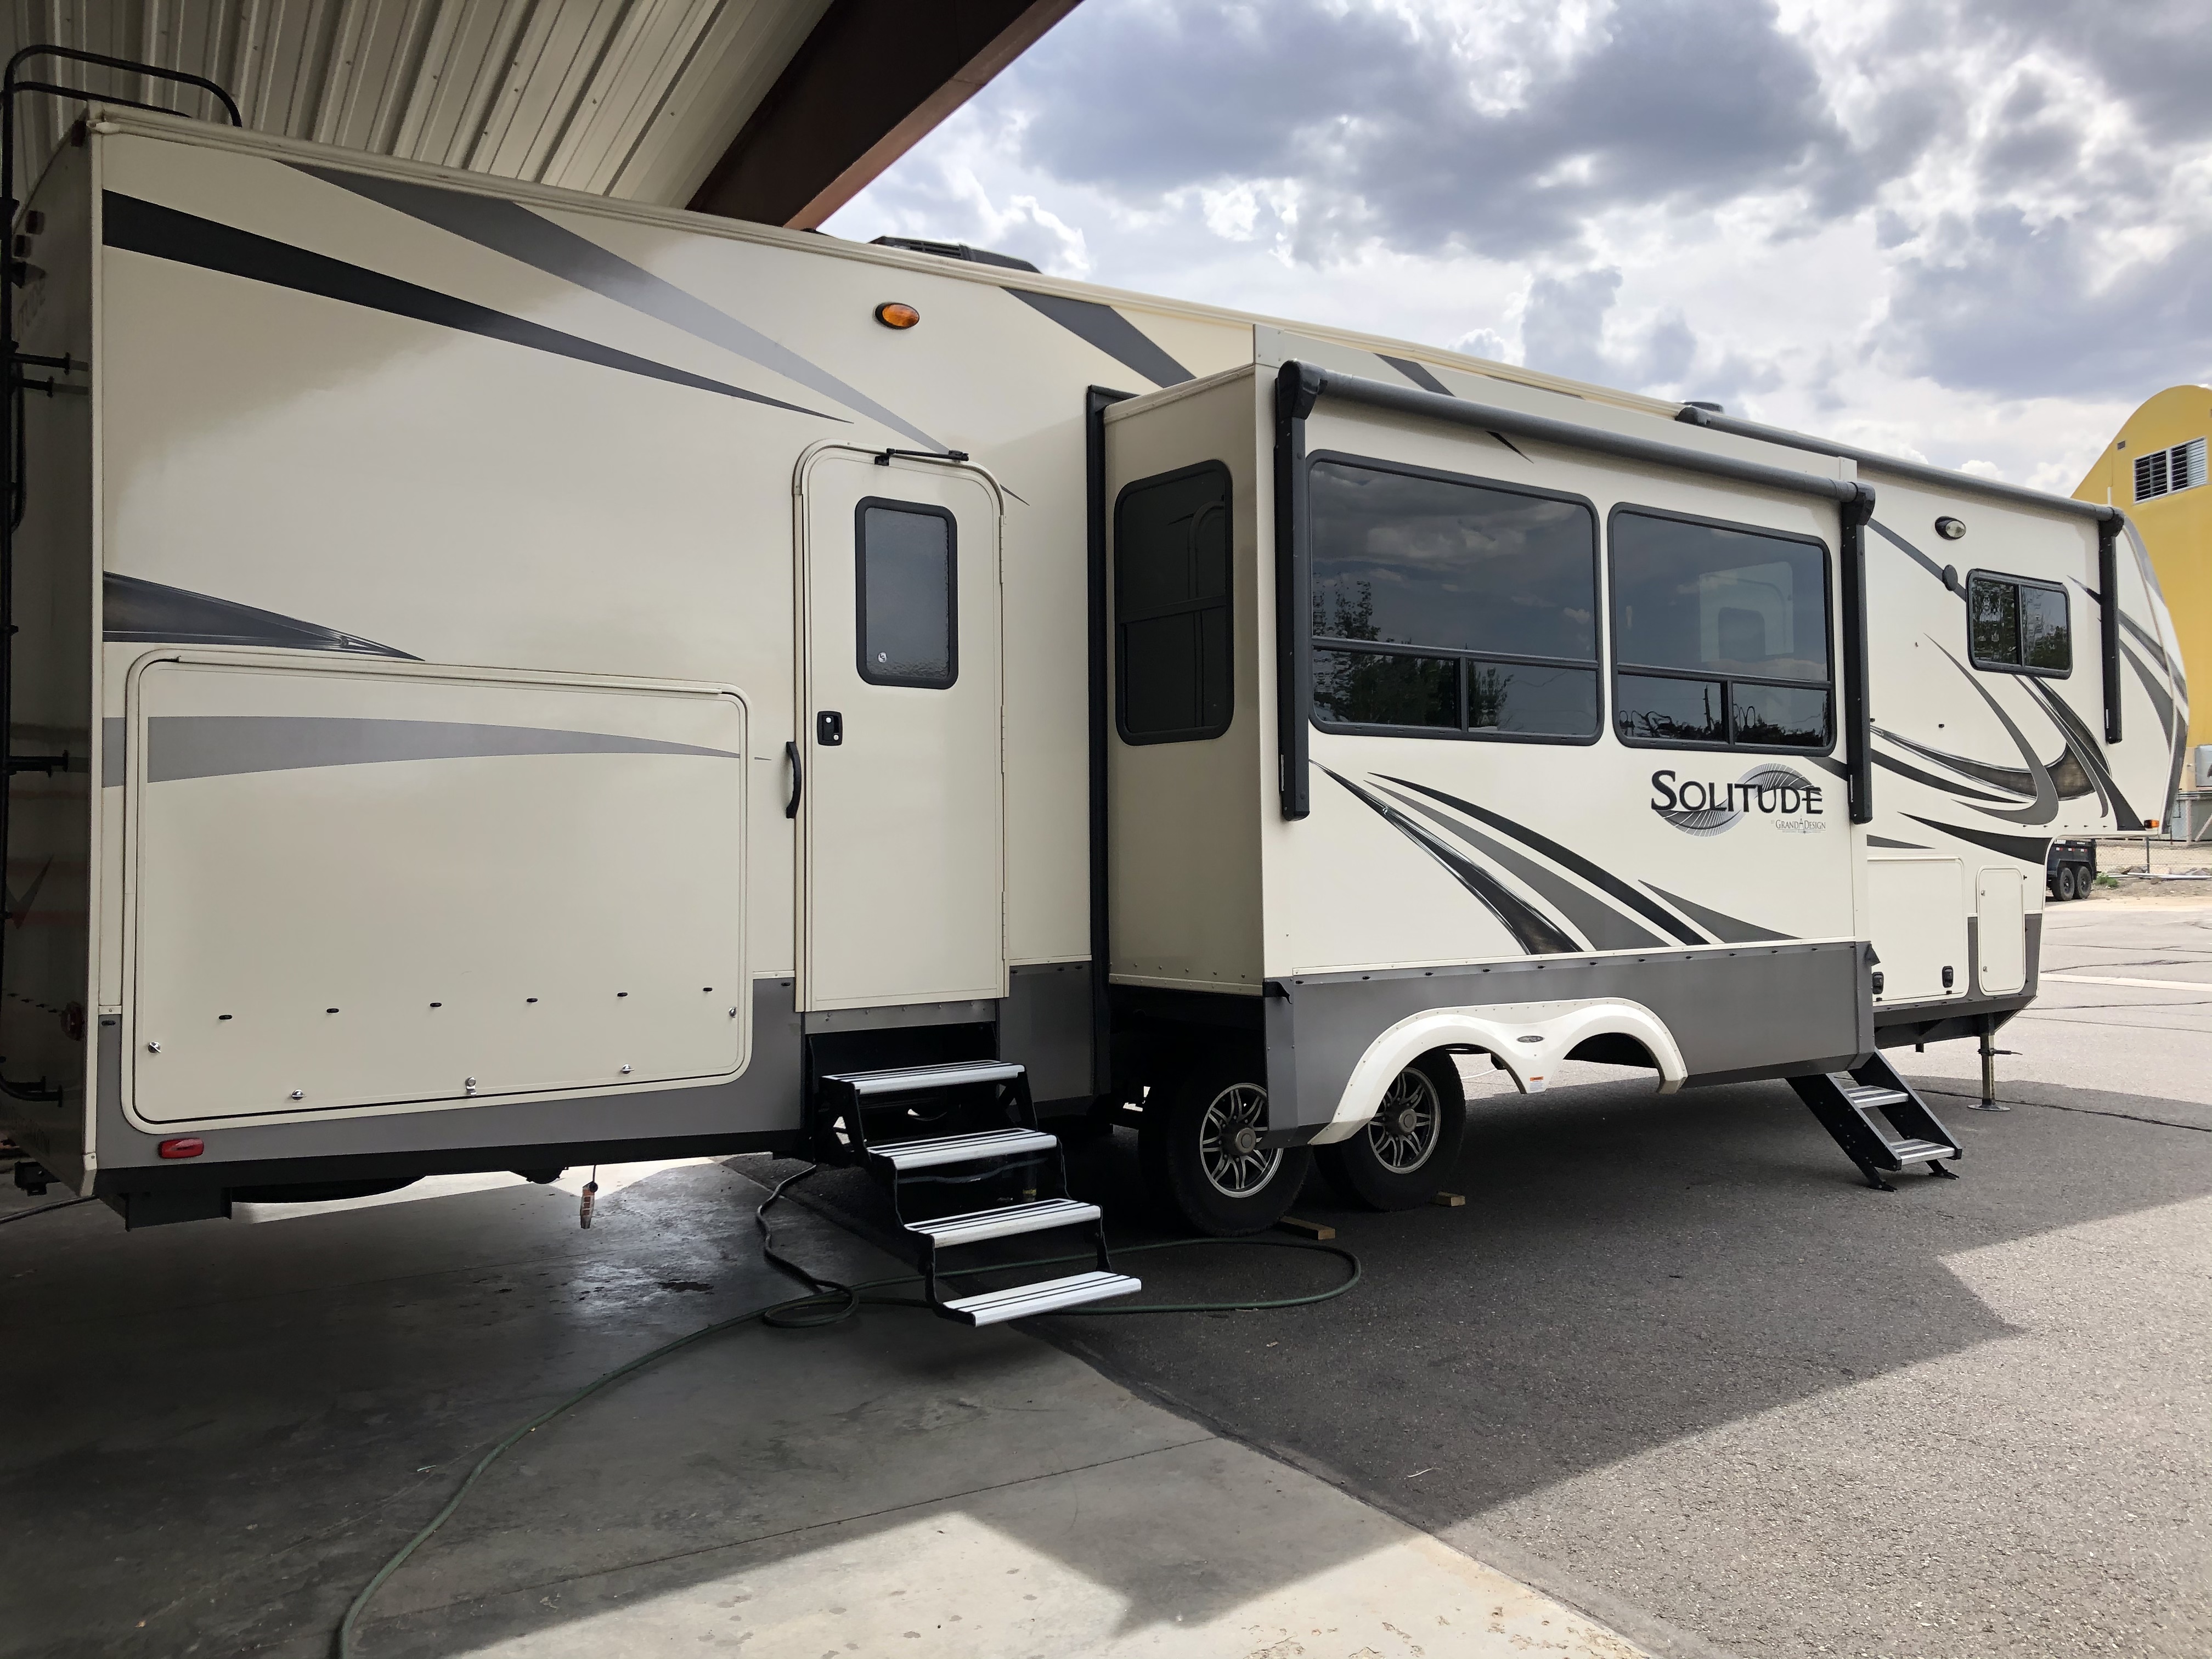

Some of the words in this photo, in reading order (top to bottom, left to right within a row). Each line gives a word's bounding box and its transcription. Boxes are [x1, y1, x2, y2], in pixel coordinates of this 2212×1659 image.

[1651, 770, 1824, 815] SOLITUDE
[1775, 819, 1799, 829] GRAND
[1804, 820, 1826, 830] DESIGN
